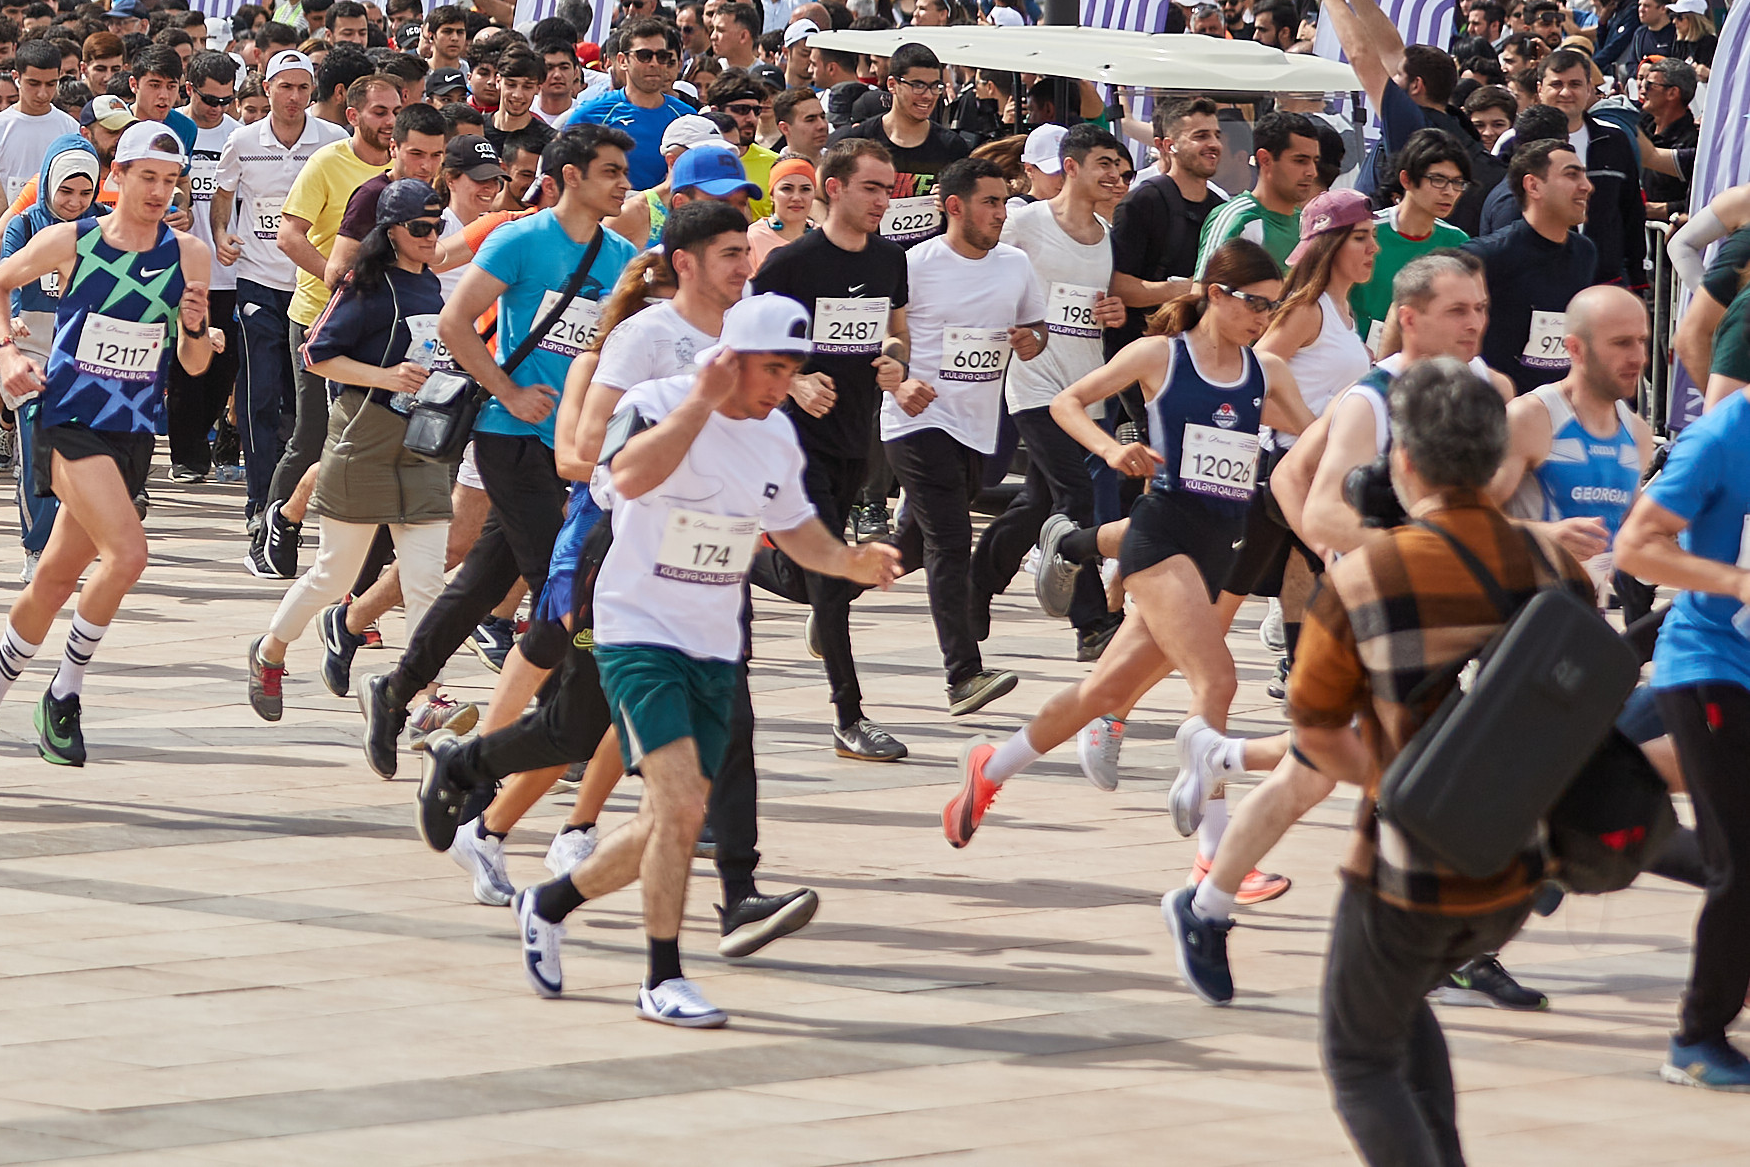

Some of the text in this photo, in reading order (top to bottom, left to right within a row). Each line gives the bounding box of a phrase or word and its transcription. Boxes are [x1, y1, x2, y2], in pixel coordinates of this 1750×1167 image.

[892, 213, 933, 231] 6222
[828, 322, 878, 340] 2487
[96, 342, 149, 366] 12117
[954, 350, 1001, 368] 6028
[1193, 454, 1251, 483] 12026
[1571, 486, 1628, 503] GEORGIA
[692, 543, 730, 567] 174
